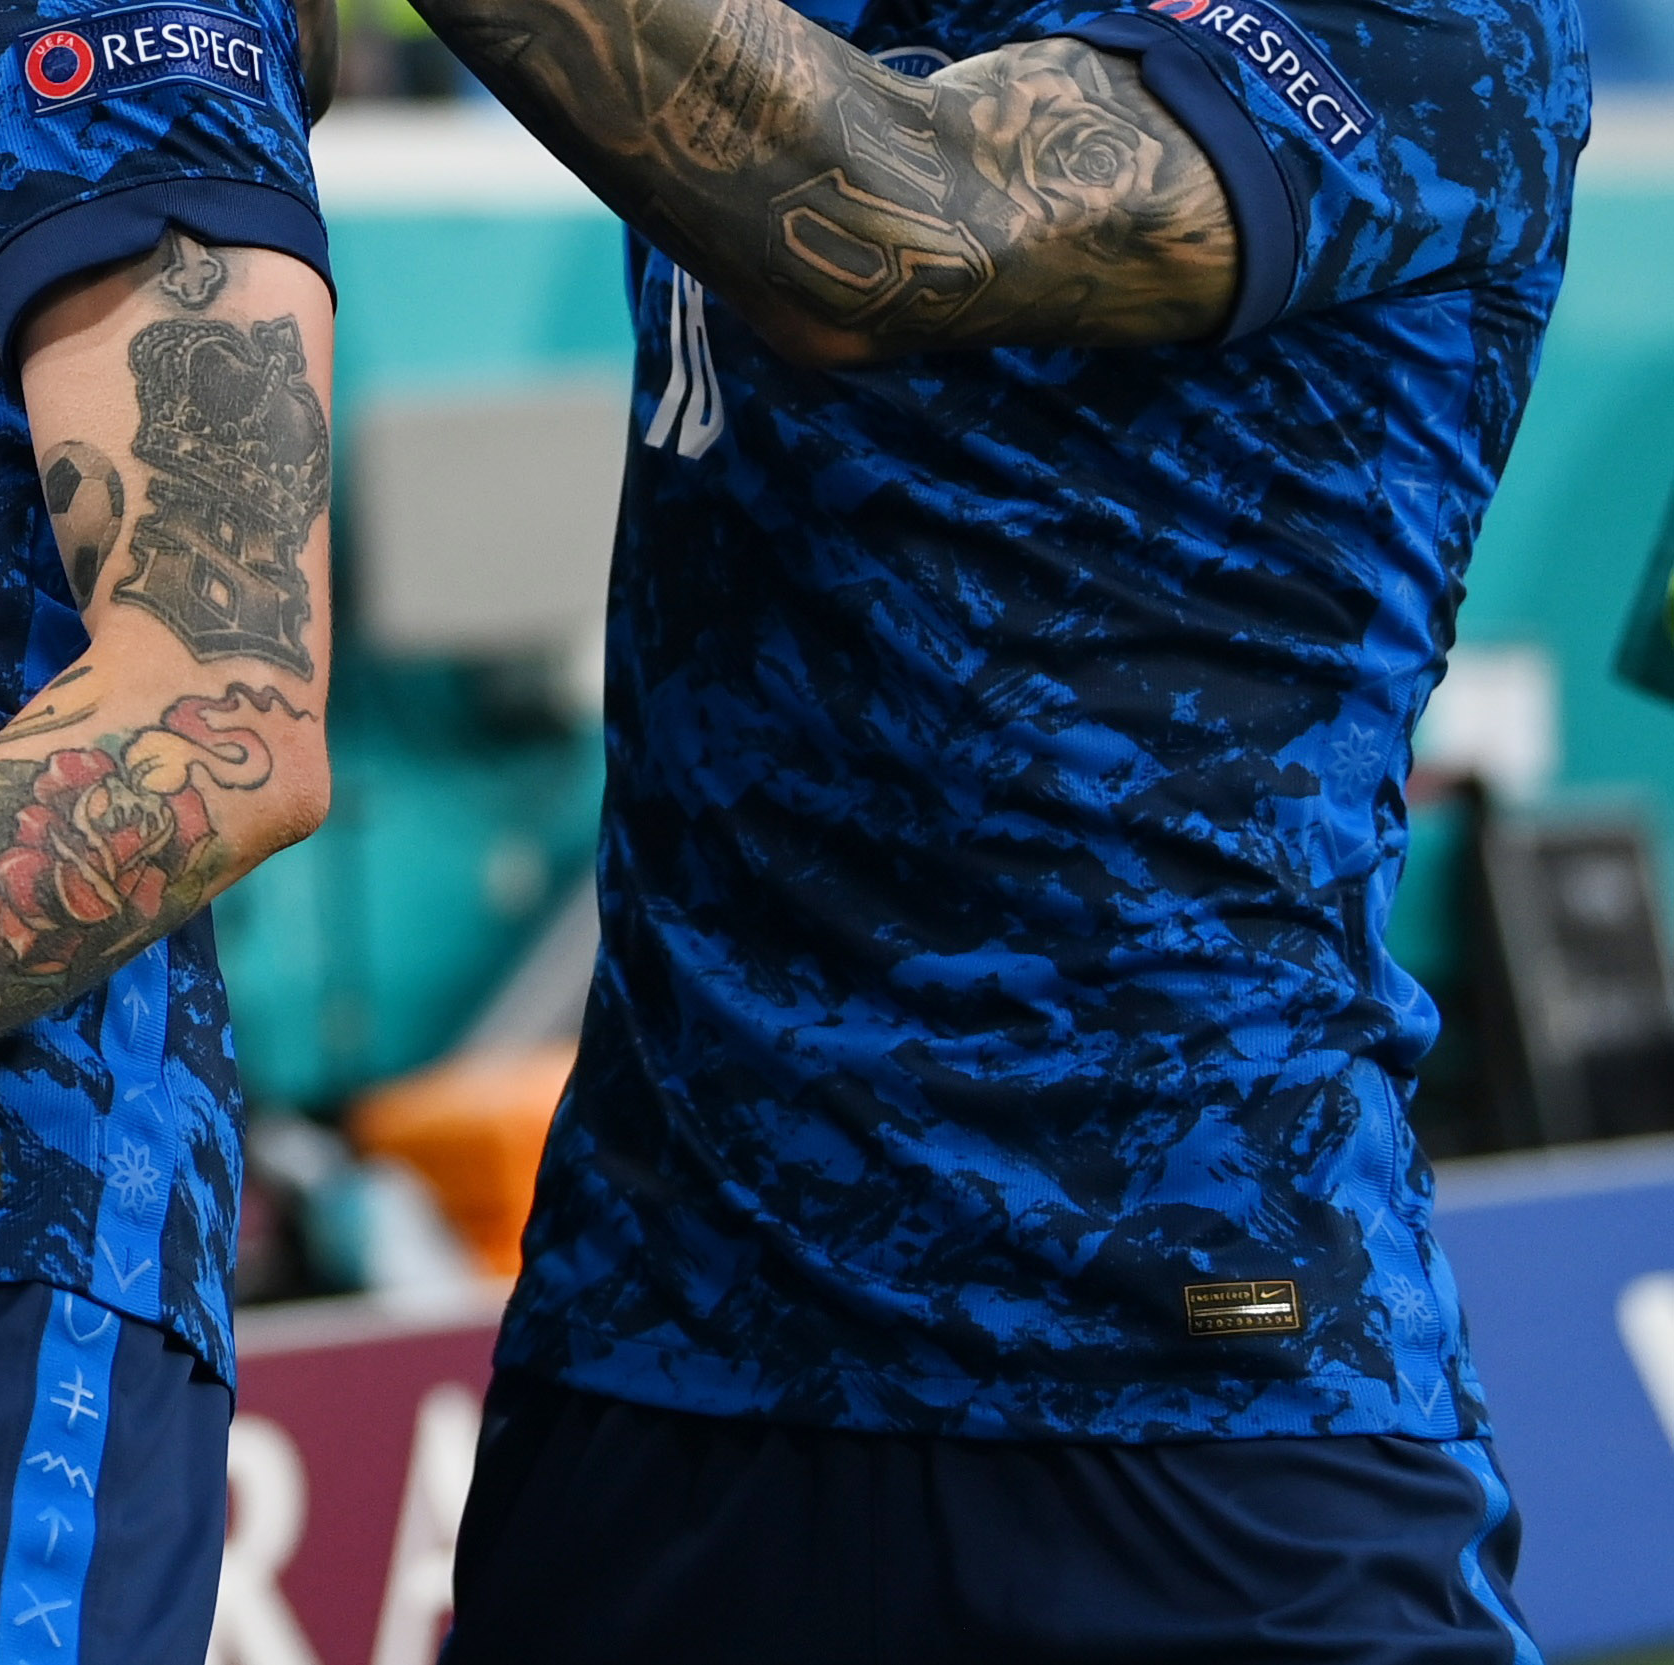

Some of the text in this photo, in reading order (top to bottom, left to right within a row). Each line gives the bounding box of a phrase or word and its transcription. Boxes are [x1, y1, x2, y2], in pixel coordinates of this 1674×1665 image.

[35, 34, 75, 55] UEFA
[101, 23, 263, 81] RESPECT
[1200, 5, 1362, 145] RESPECT
